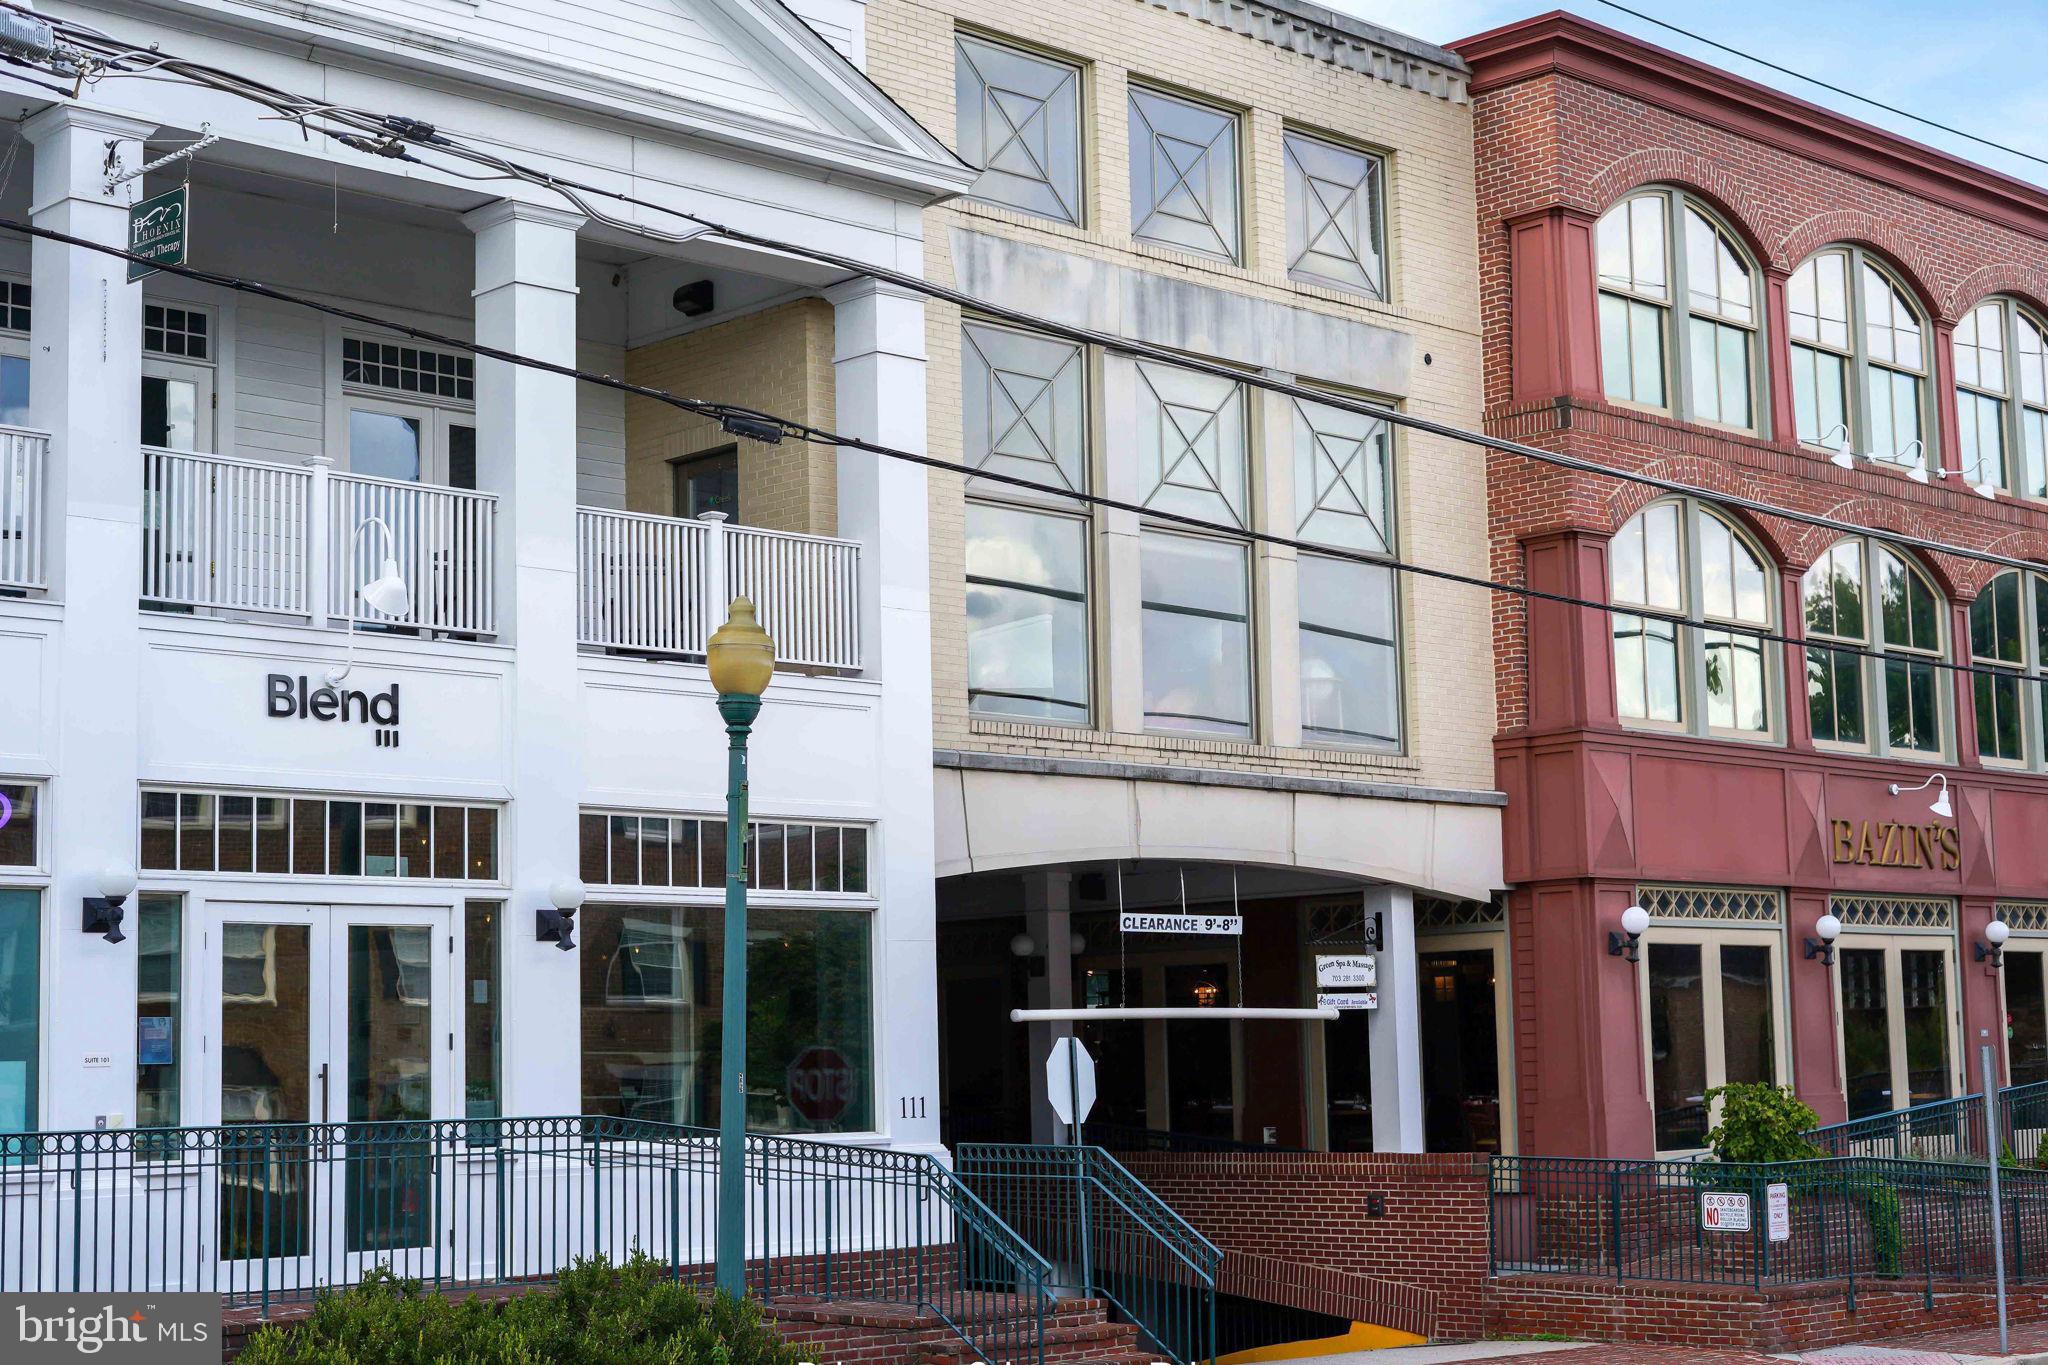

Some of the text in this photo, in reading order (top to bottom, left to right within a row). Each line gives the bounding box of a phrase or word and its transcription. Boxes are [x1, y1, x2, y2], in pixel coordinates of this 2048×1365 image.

[133, 217, 181, 244] PHOENIX
[156, 240, 181, 255] Therapy
[267, 673, 399, 726] Blend
[1831, 819, 1960, 870] BAZIN'S
[1122, 916, 1198, 931] CLEARANCE
[1318, 959, 1374, 972] Green Spa & Massage
[898, 1096, 927, 1119] 111
[1706, 1207, 1719, 1226] NO
